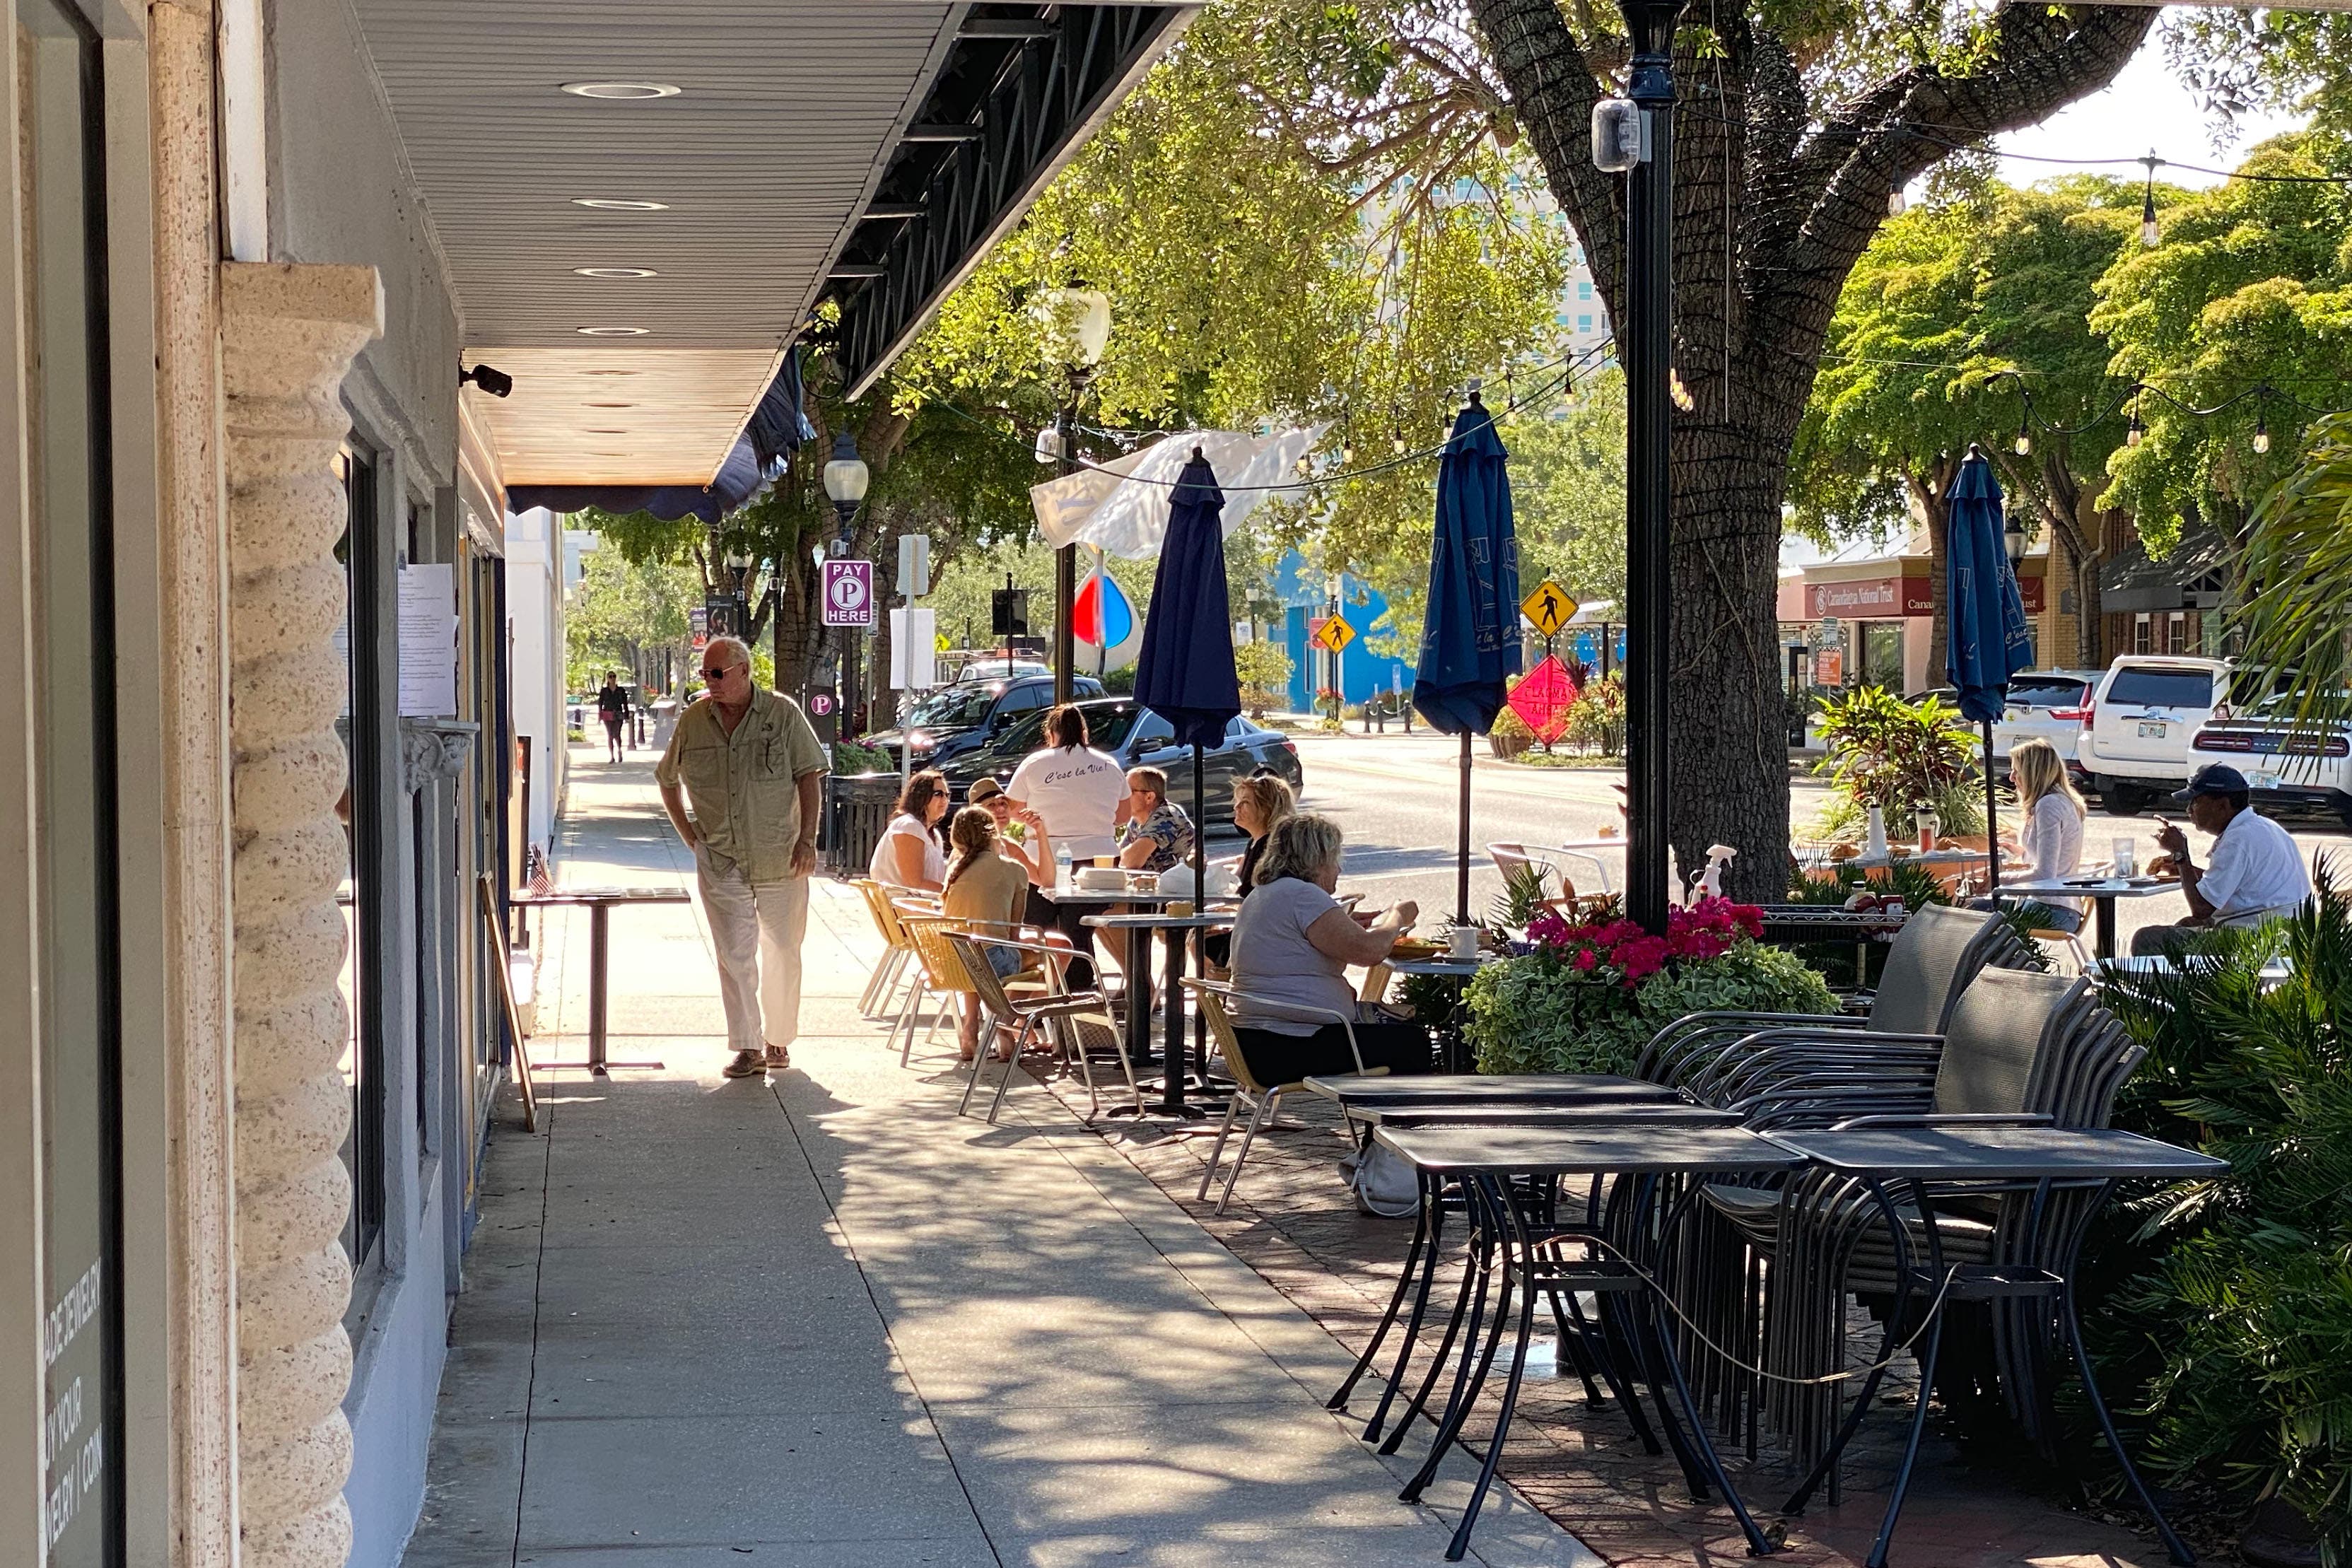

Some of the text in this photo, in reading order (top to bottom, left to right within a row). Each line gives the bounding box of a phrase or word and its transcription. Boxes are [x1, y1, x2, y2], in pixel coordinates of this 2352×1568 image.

[833, 565, 863, 576] PAY
[841, 583, 858, 604] P
[1859, 586, 1879, 604] National
[1879, 585, 1894, 602] Trust
[828, 610, 868, 622] HERE
[816, 697, 829, 713] P
[1045, 772, 1072, 783] C'est
[1088, 763, 1107, 773] Vie!
[57, 1376, 81, 1451] YOUR
